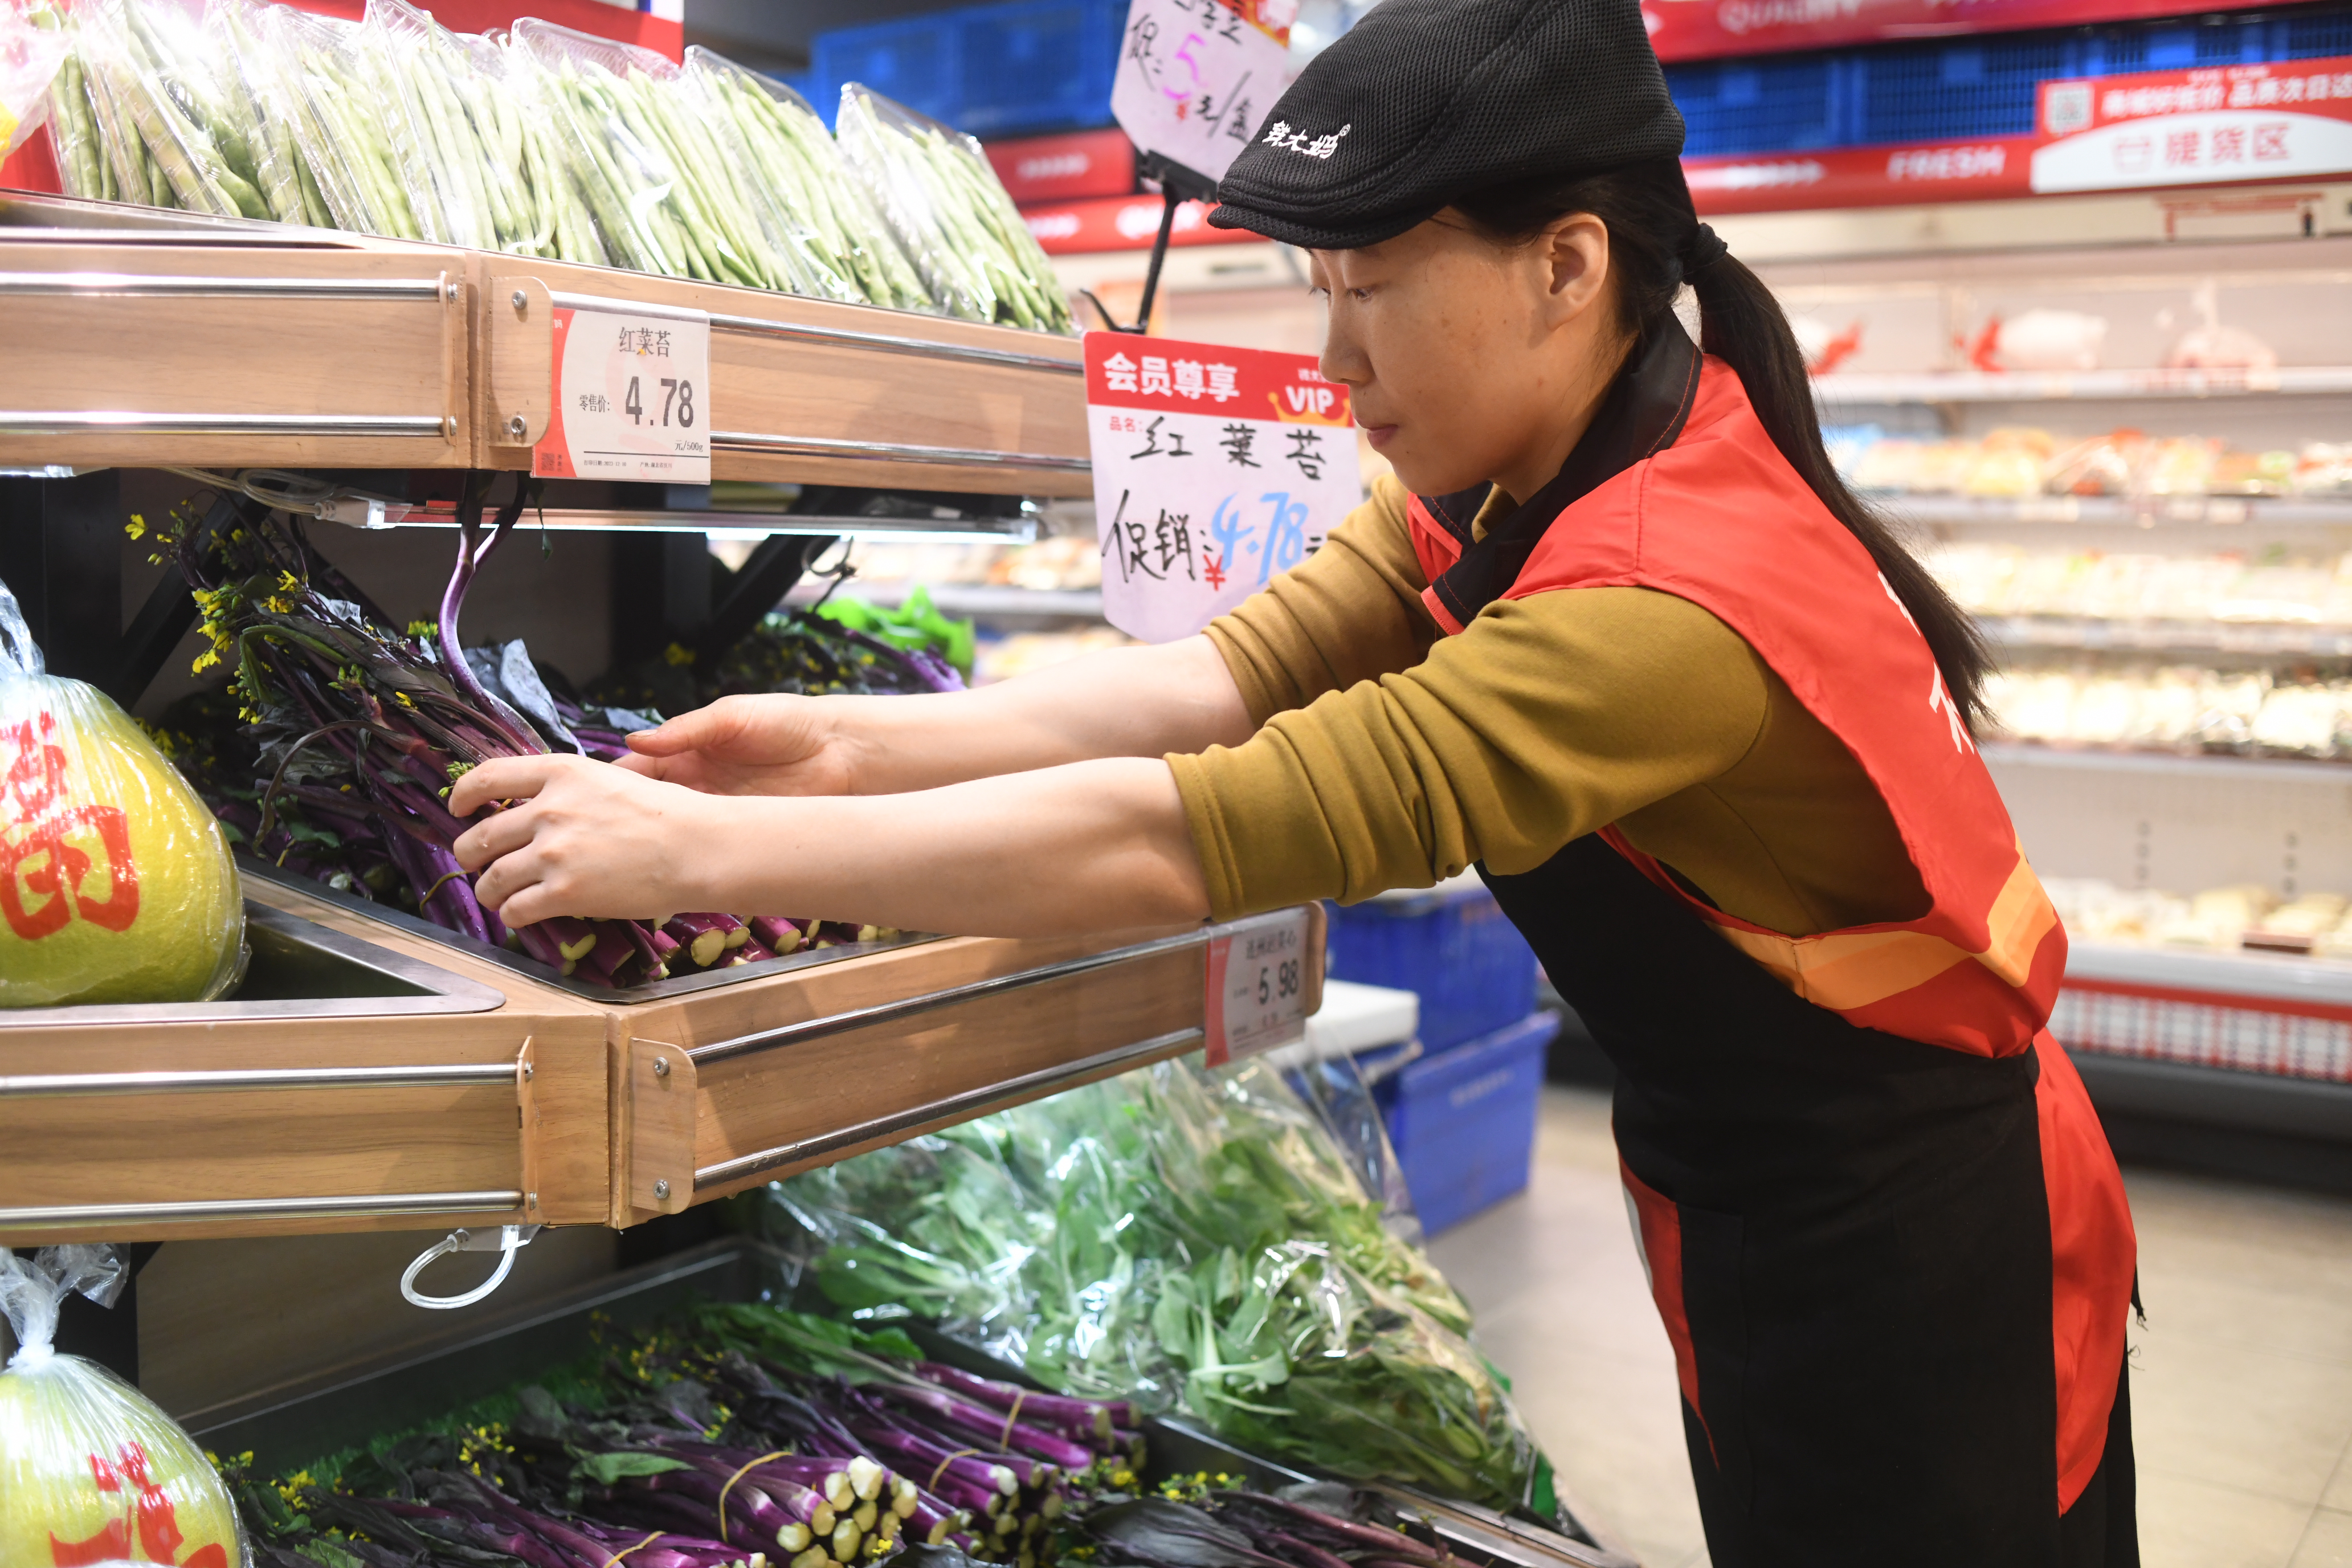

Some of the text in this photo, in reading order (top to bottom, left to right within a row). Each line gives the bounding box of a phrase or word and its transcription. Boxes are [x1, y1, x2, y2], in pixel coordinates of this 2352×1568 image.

[1886, 145, 2007, 182] FRESH
[619, 326, 671, 358] 红菜苔
[1103, 352, 1240, 402] 会员尊享
[579, 393, 611, 414] 零售价:
[625, 375, 695, 428] 4.78
[1285, 385, 1335, 414] VIP
[675, 439, 704, 453] 元/500g
[1211, 492, 1309, 587] 4.78
